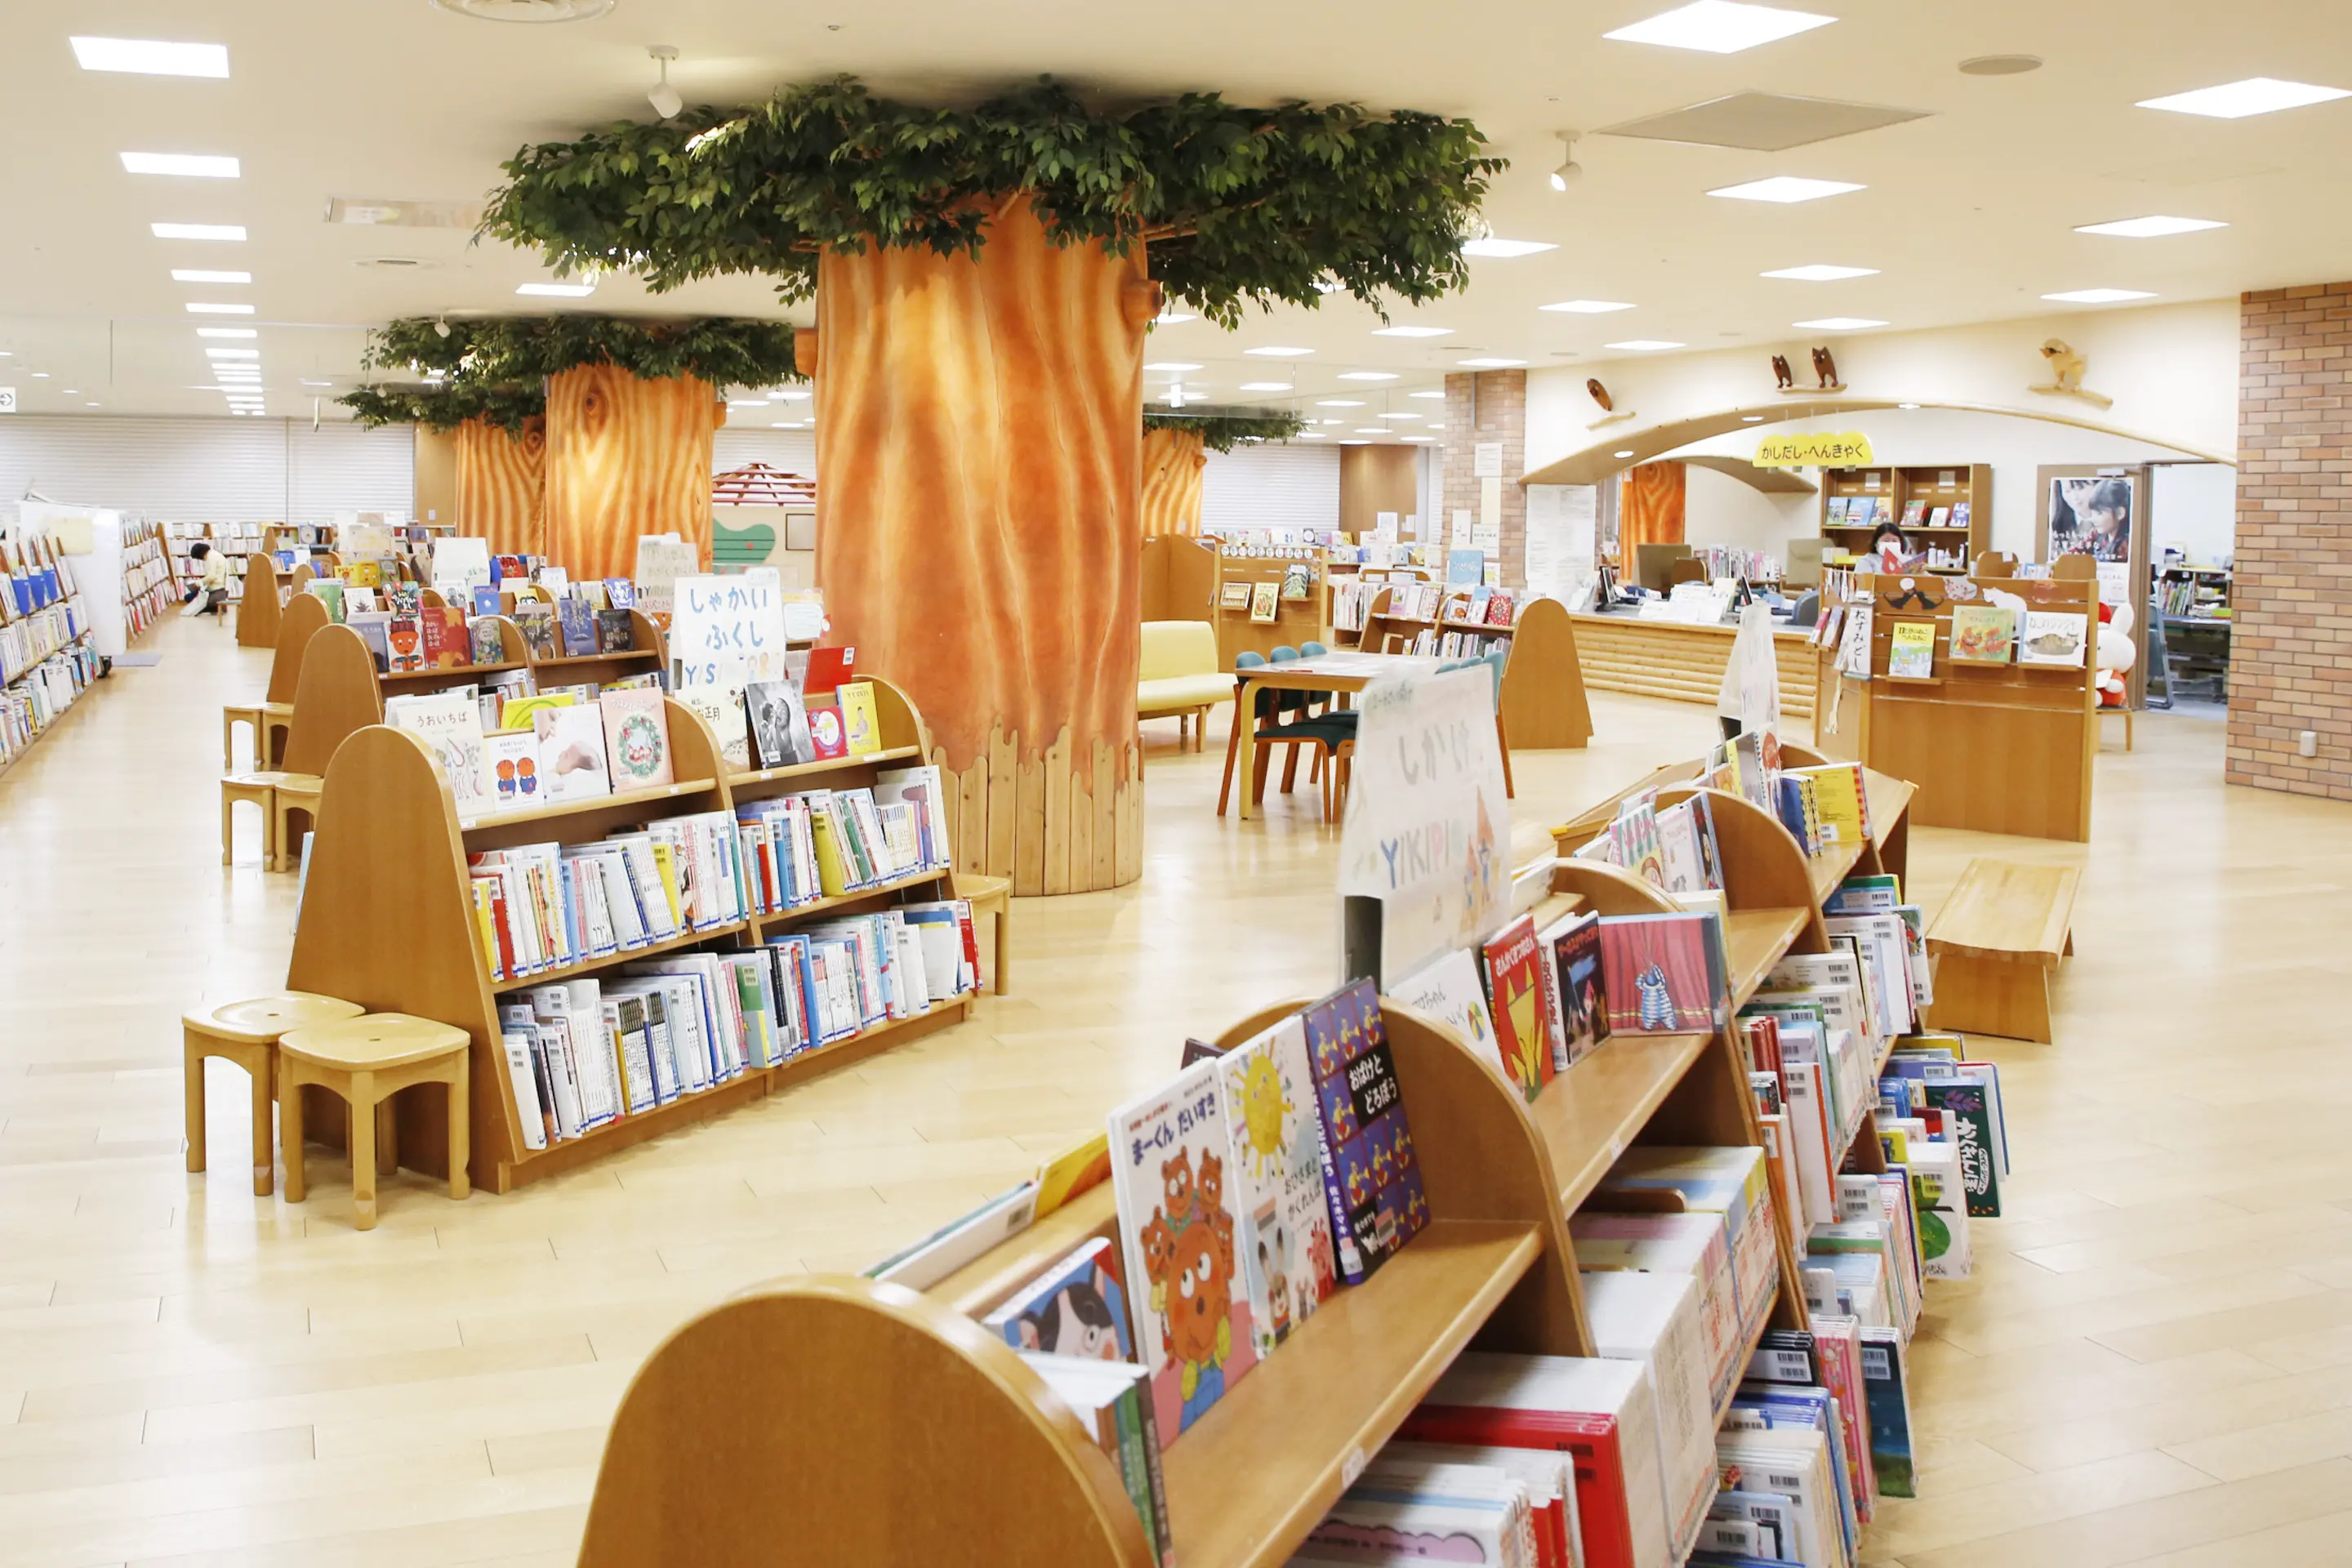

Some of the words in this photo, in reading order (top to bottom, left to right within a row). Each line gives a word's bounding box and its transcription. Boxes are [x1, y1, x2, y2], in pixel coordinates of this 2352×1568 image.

[690, 586, 767, 613] しゃかい
[706, 621, 764, 650] ふくし
[417, 711, 467, 728] うおいちば
[1349, 1053, 1384, 1092] おばけと
[1364, 1076, 1397, 1115] どろぼう
[1132, 1120, 1174, 1167] まーくん
[1178, 1092, 1215, 1137] だいすき
[1957, 1116, 1980, 1193] かくれんぼ
